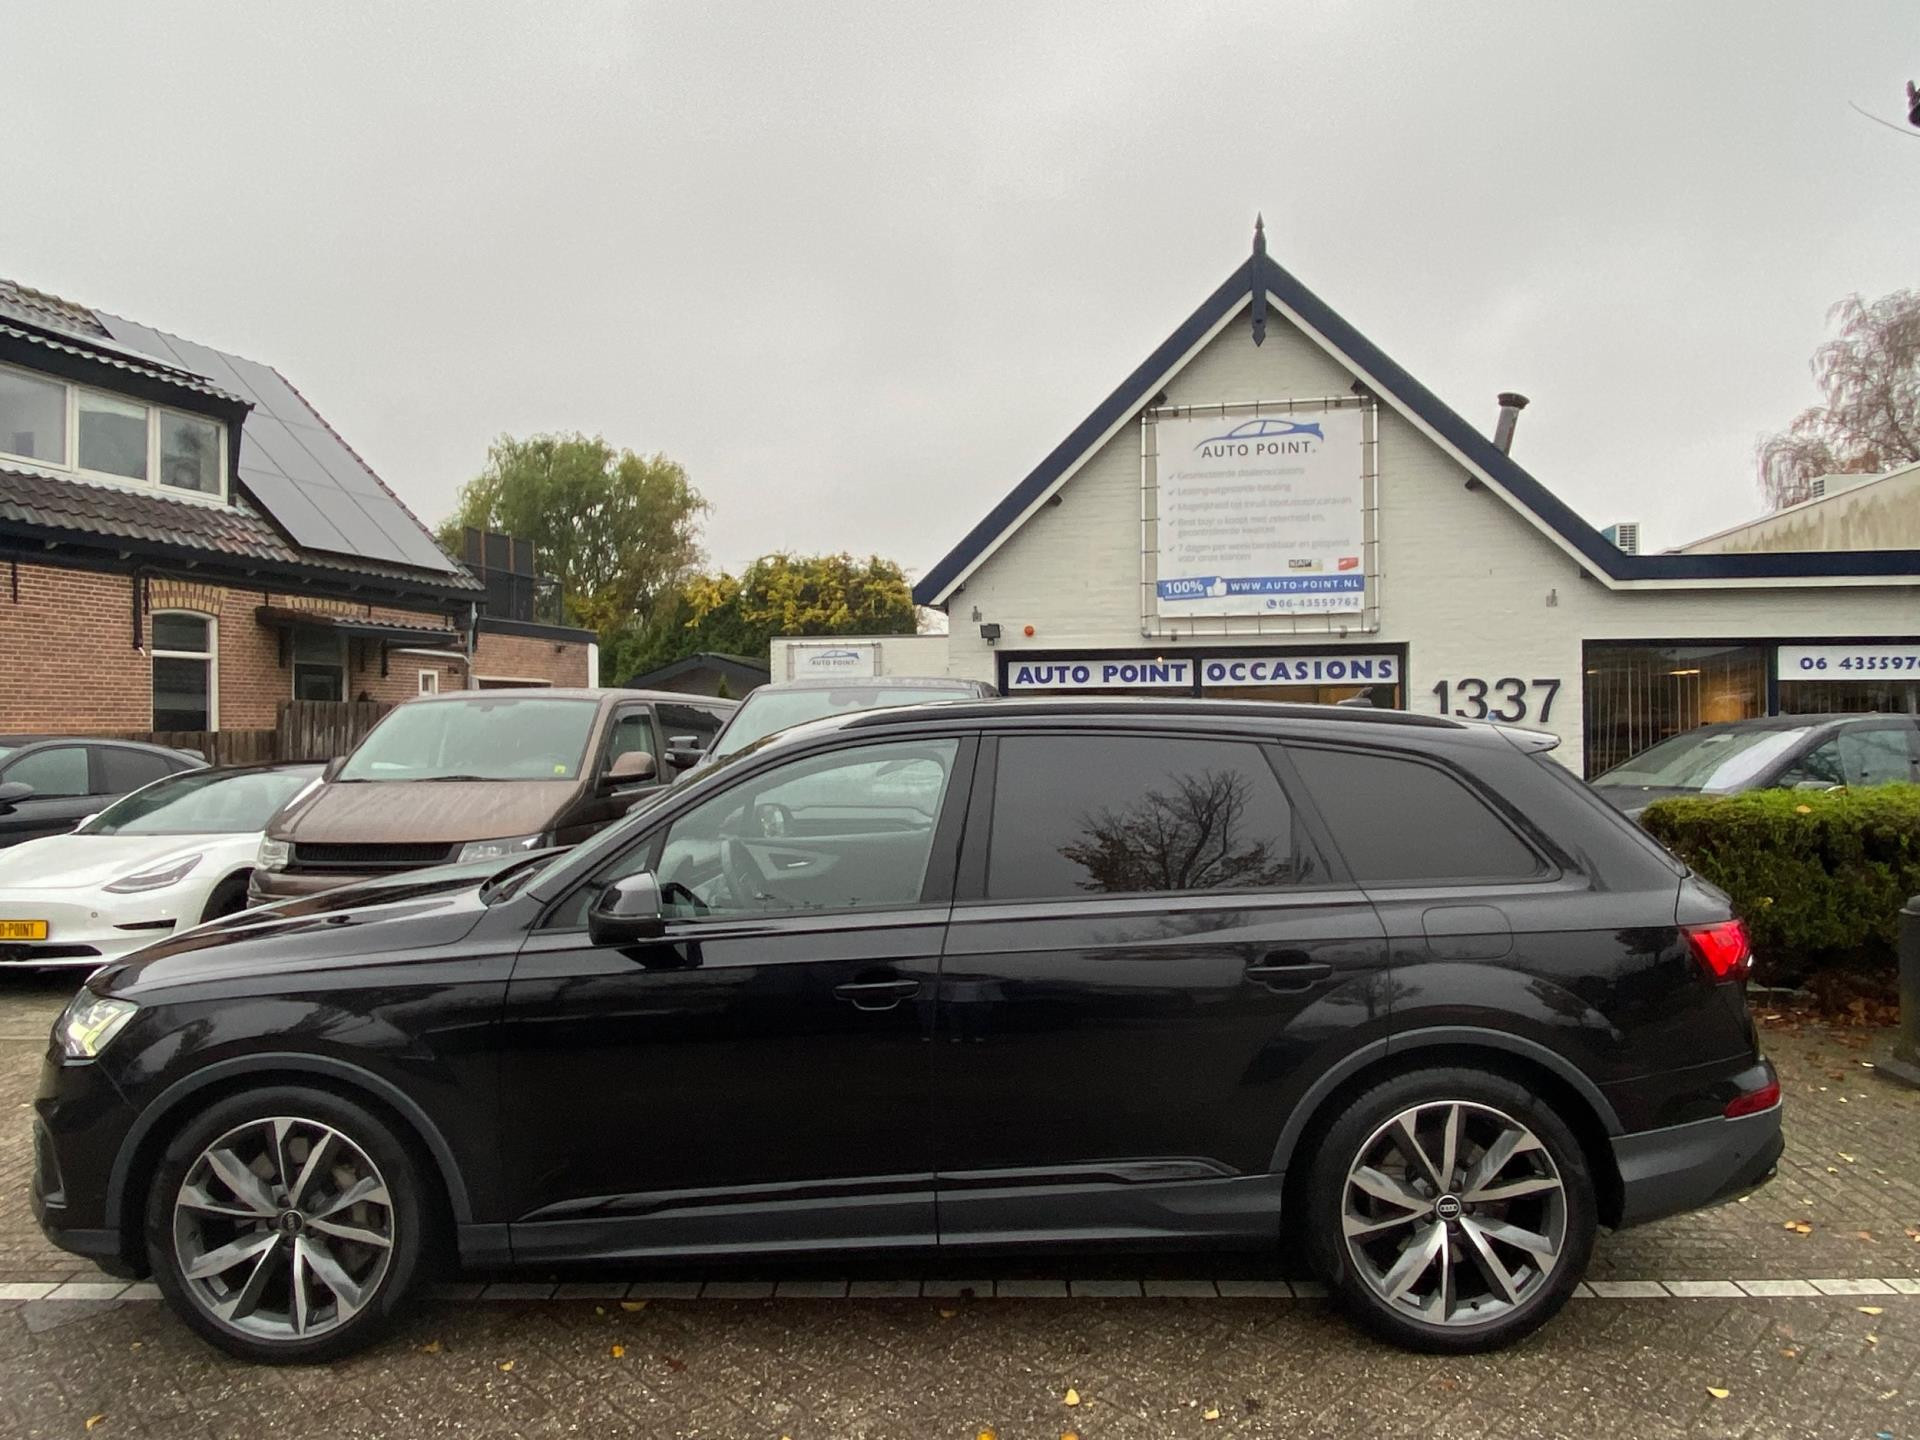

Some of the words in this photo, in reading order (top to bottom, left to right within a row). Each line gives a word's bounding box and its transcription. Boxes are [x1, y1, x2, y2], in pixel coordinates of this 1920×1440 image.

[1201, 444, 1249, 458] AUTO
[1165, 580, 1204, 594] 100%
[1206, 660, 1392, 681] OCCASIONS
[1800, 657, 1828, 670] 06
[1838, 656, 1920, 670] 435597
[1015, 665, 1091, 684] AUTO
[1103, 664, 1187, 683] POINT
[1432, 678, 1561, 723] 1337
